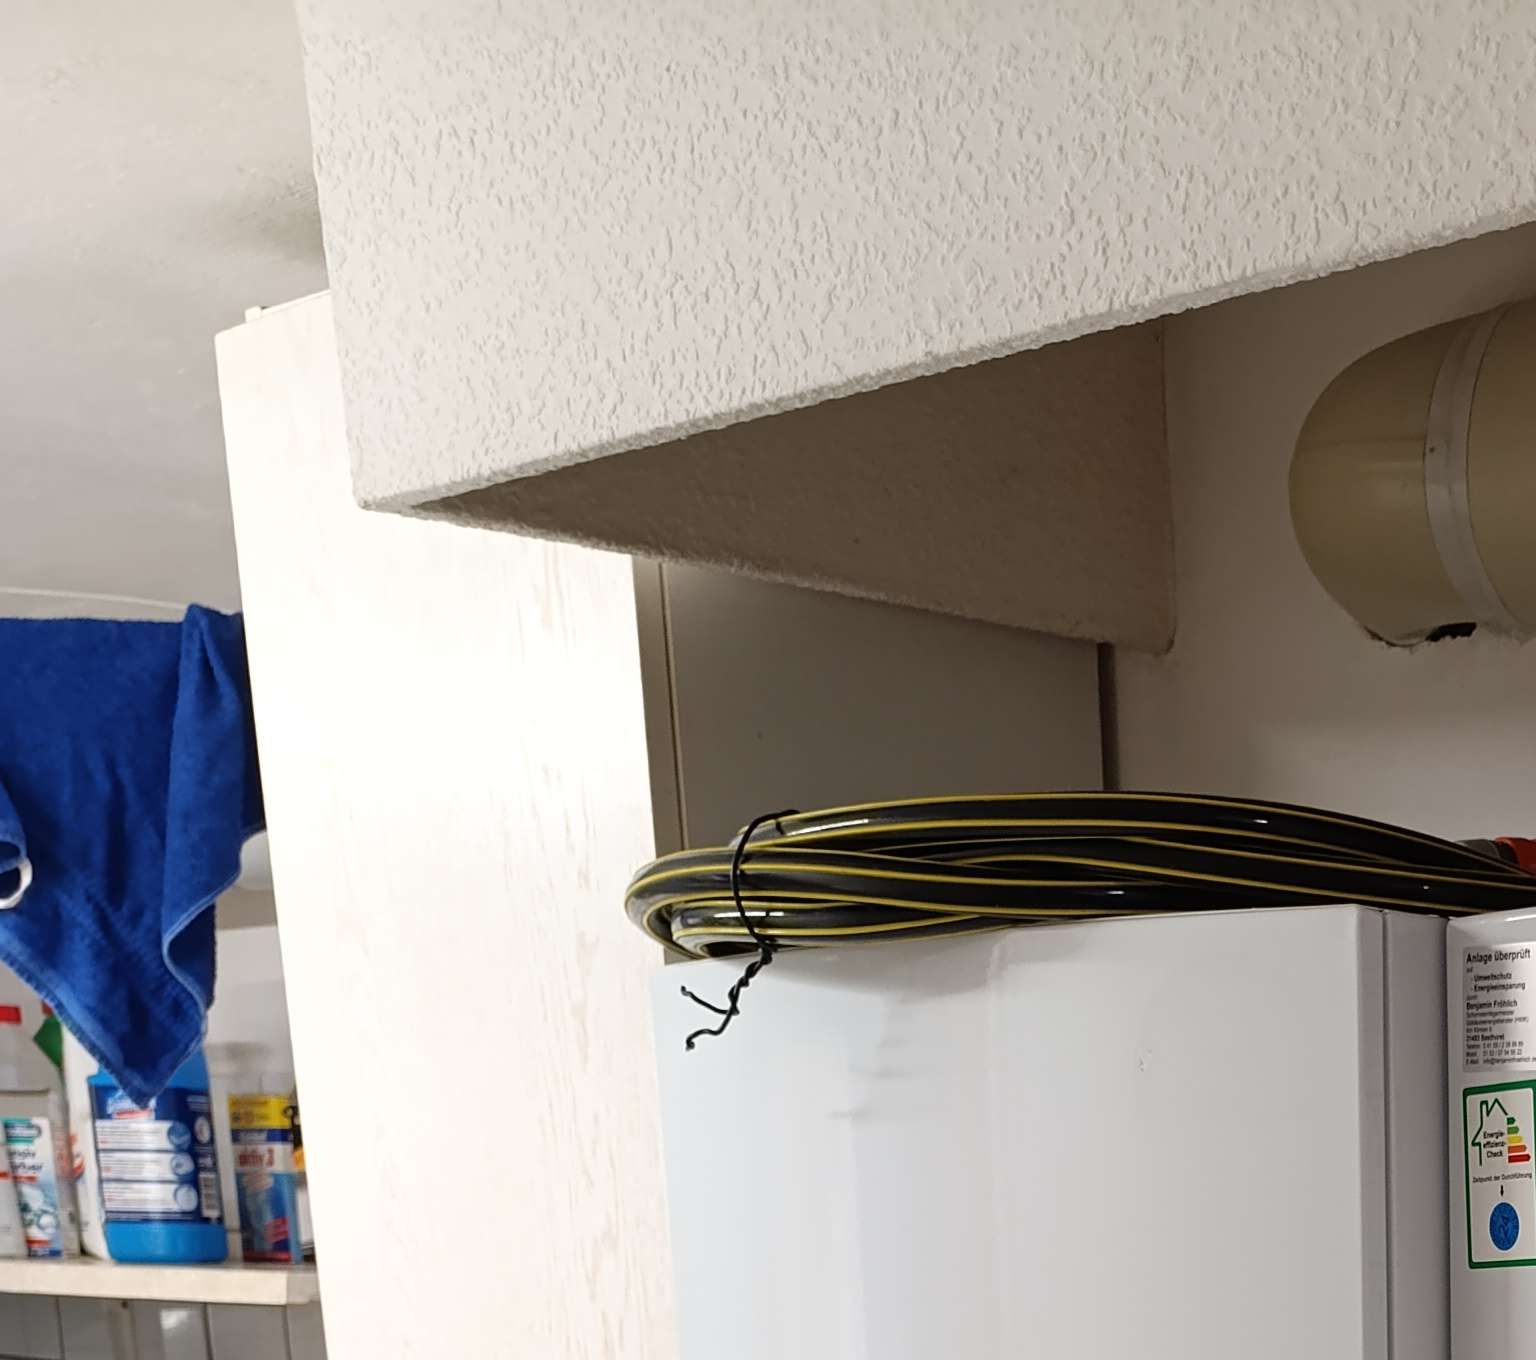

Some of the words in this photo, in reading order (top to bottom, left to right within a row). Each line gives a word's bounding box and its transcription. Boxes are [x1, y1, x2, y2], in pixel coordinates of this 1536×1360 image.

[1466, 952, 1493, 965] Anlage
[1494, 948, 1531, 963] überprüft
[1486, 1150, 1504, 1158] Check
